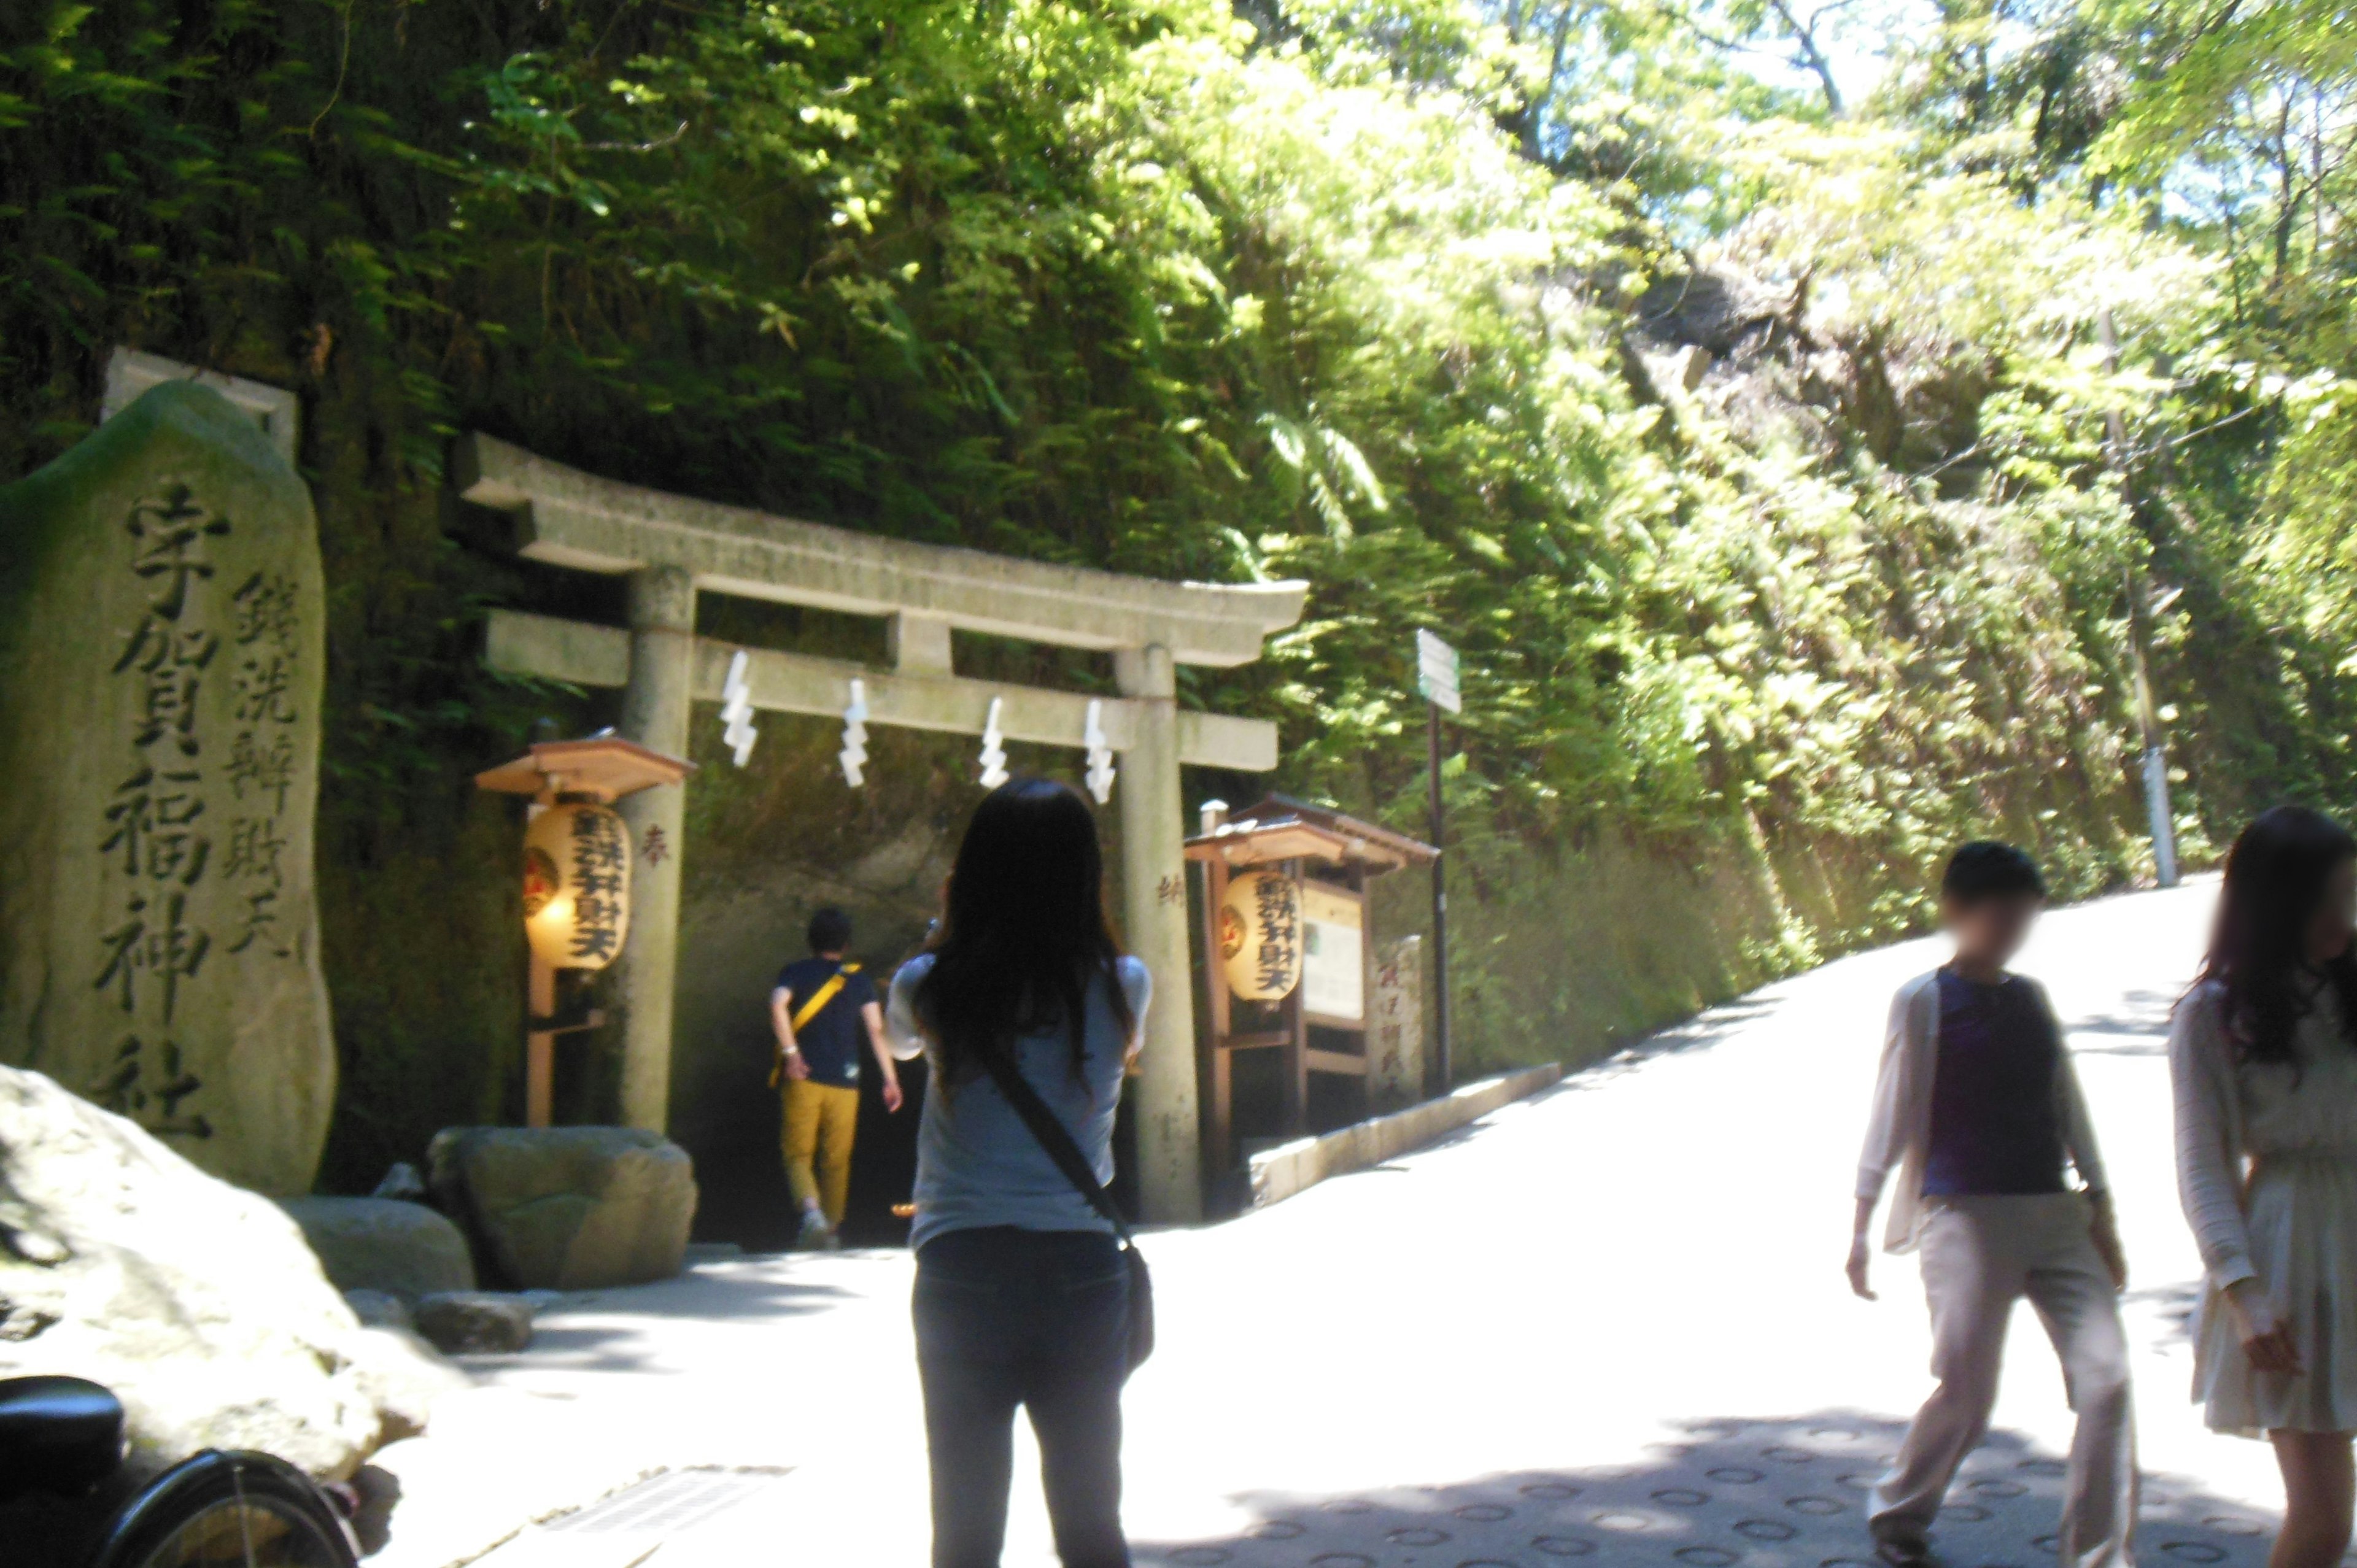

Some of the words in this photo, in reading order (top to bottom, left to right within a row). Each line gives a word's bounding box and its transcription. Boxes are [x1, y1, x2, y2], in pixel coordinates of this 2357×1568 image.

[90, 480, 231, 1139] 宇賀福神社
[642, 824, 670, 868] 奉
